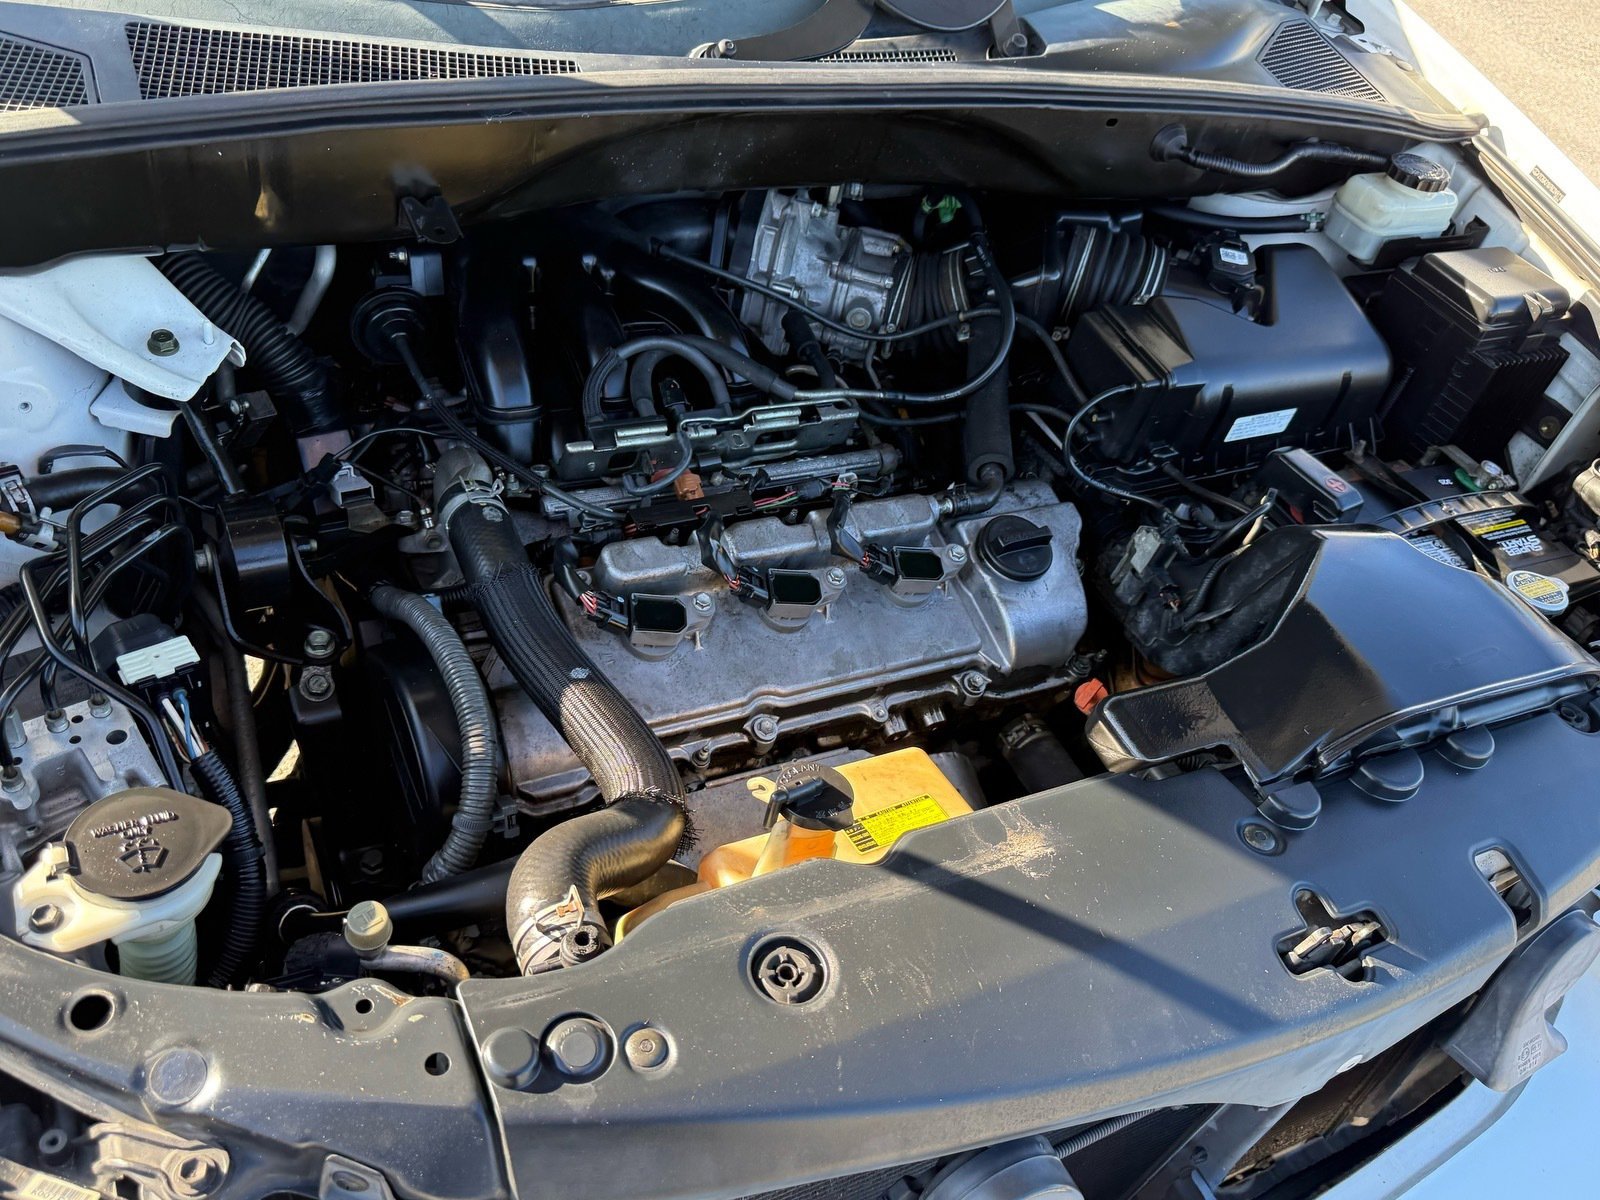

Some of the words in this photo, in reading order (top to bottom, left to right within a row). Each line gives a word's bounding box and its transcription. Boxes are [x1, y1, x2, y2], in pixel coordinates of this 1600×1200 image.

[1497, 535, 1542, 550] START
[1504, 543, 1543, 557] SUPER
[90, 819, 140, 838] WASHER
